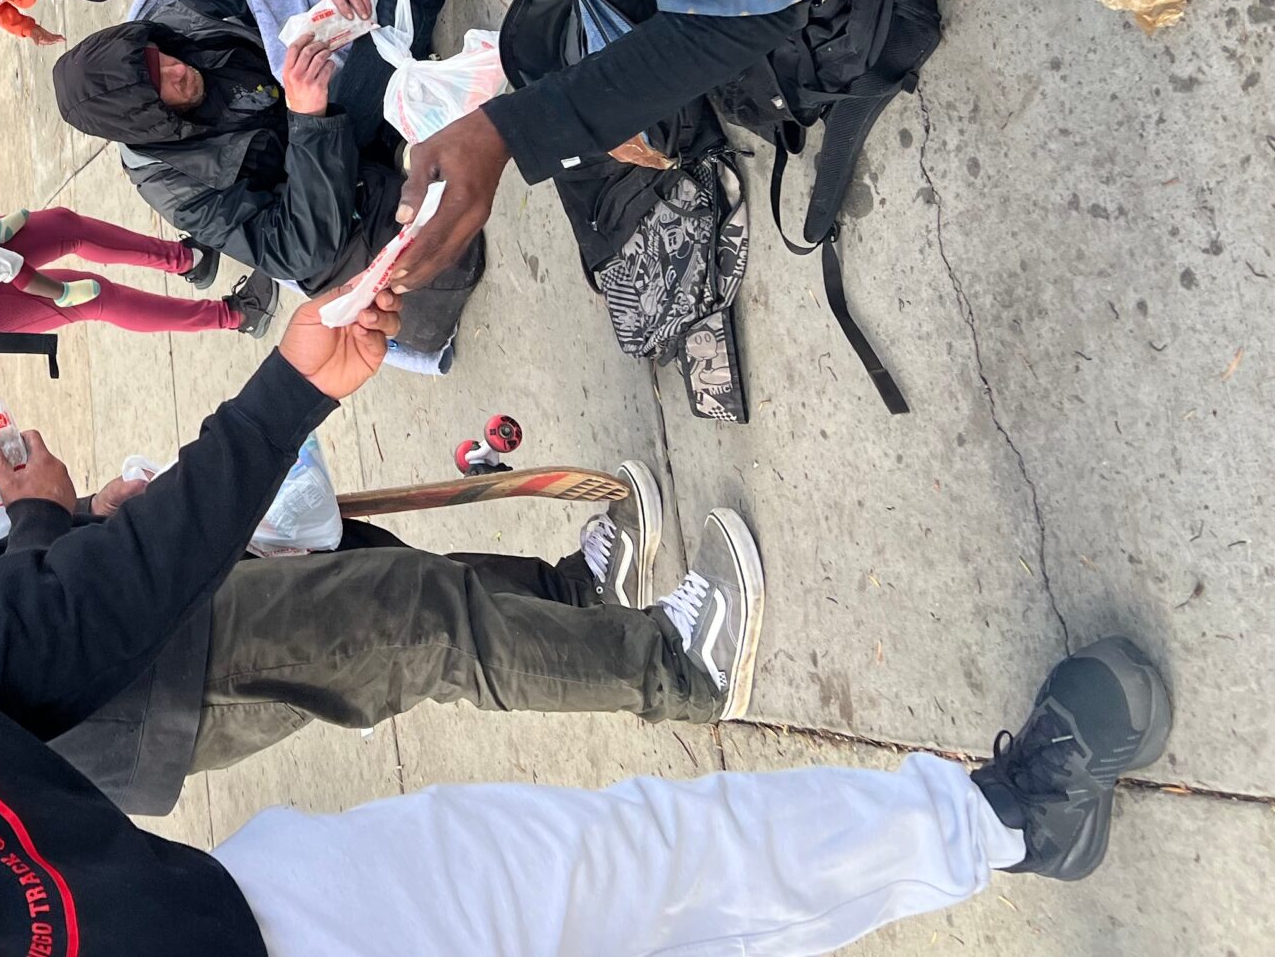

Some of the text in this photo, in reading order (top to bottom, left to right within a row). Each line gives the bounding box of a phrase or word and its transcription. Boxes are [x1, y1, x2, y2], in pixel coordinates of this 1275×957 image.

[709, 382, 733, 395] MIC
[0, 853, 50, 917] TRACK
[27, 922, 52, 957] IEGO
